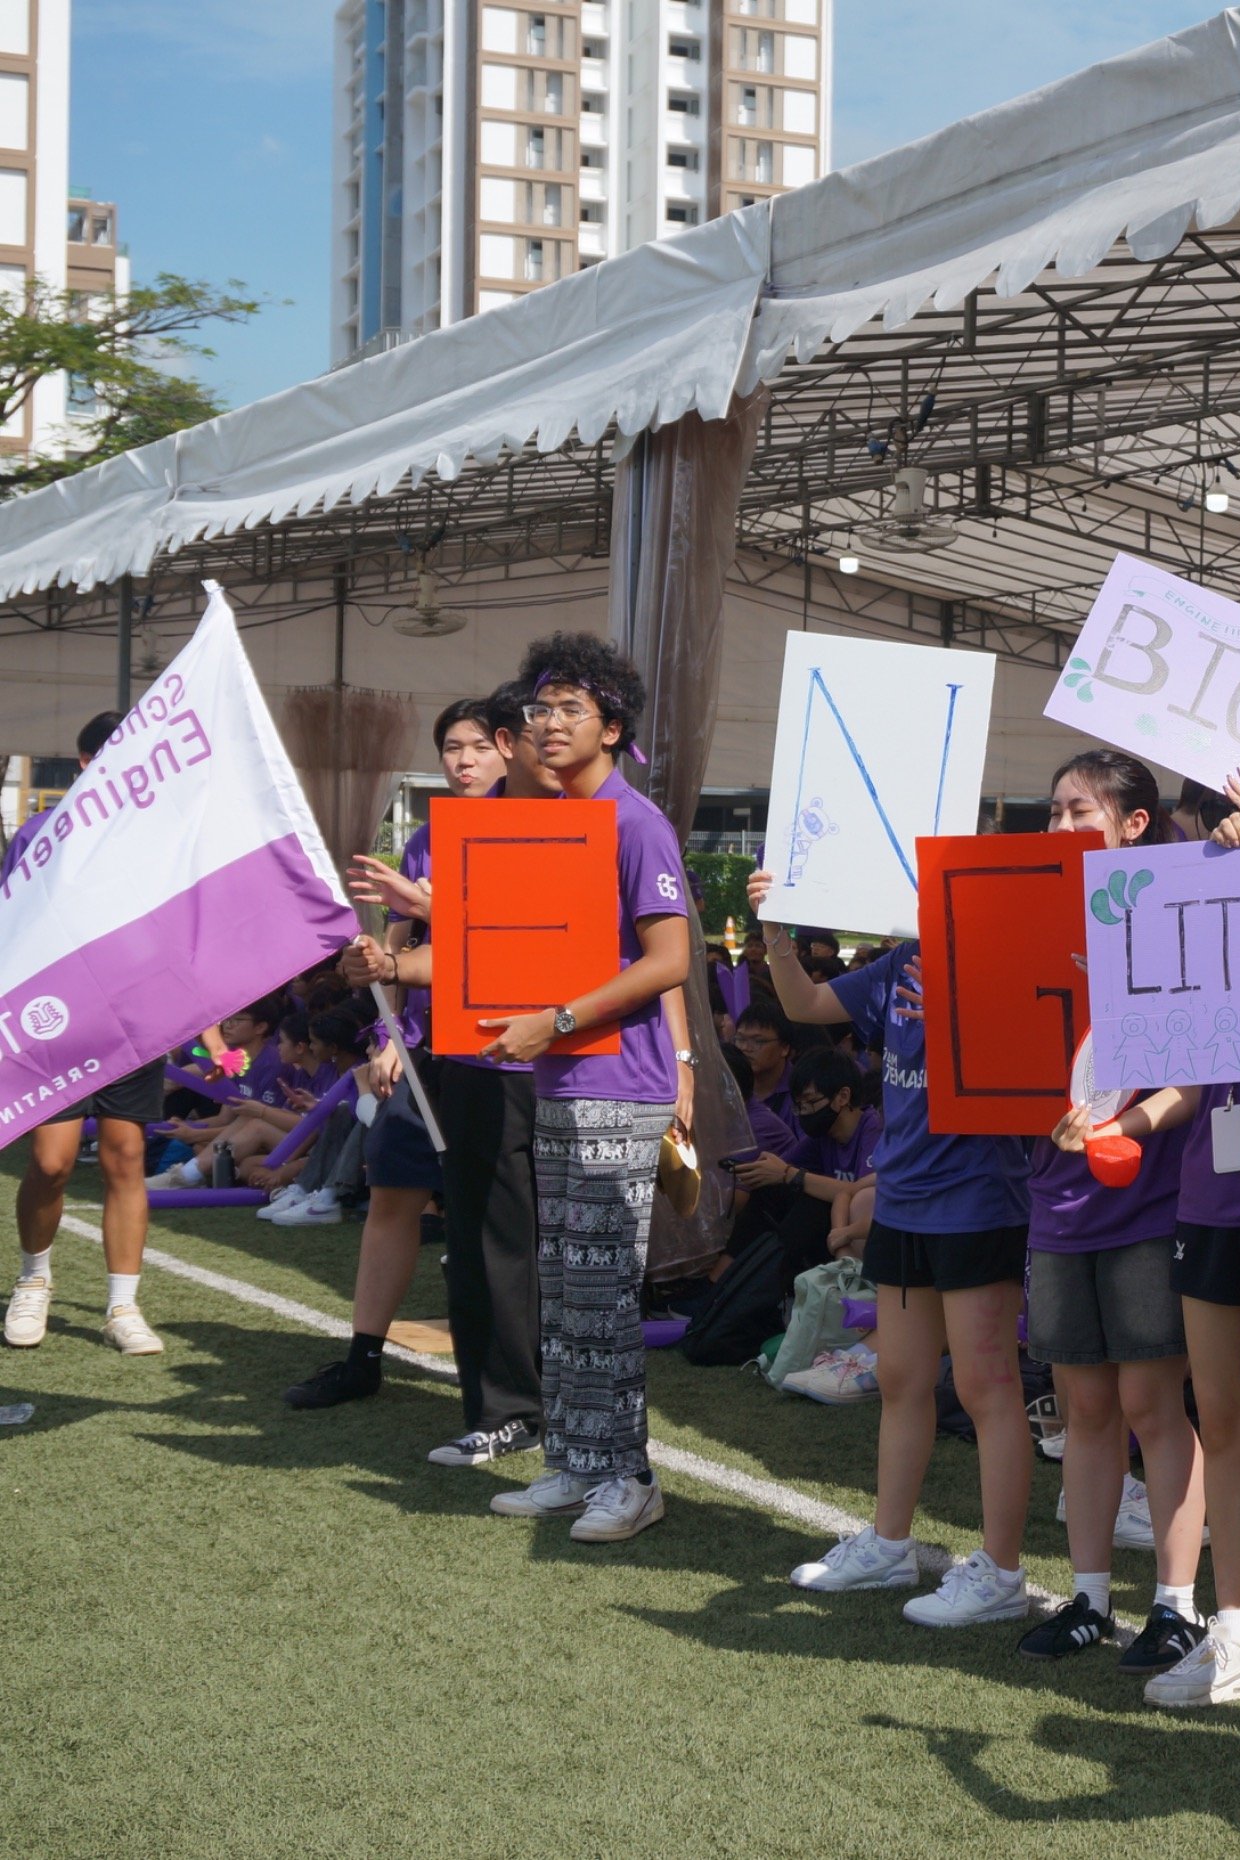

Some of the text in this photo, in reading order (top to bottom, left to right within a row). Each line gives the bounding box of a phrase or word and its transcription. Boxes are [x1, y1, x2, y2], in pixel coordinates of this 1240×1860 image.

[784, 666, 964, 890] N
[462, 833, 588, 1011] E
[942, 859, 1075, 1098] G
